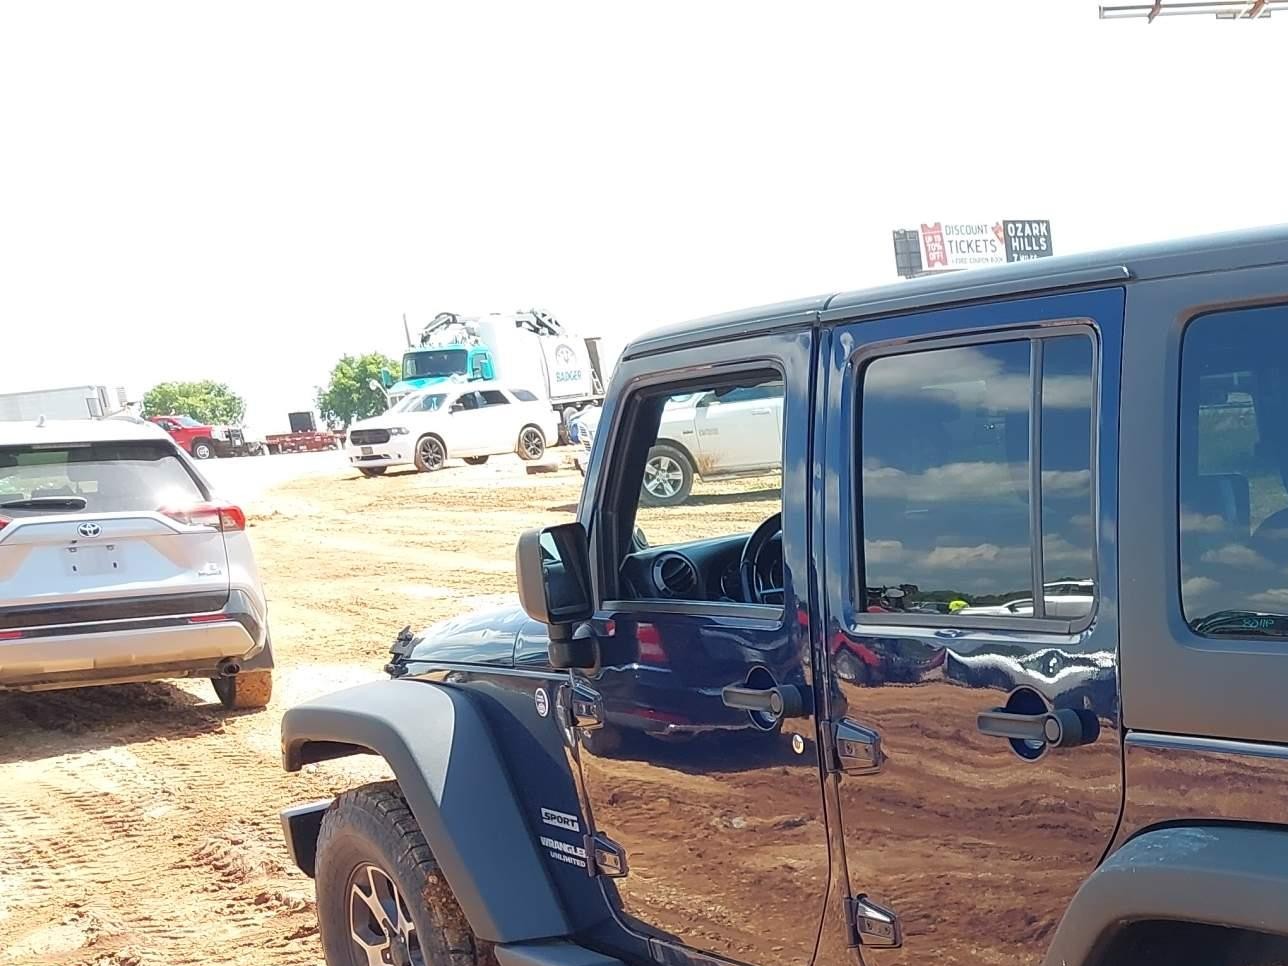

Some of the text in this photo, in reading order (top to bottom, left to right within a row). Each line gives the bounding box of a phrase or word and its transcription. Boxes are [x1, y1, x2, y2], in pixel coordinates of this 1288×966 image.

[945, 224, 989, 236] DISCOUNT
[1007, 222, 1048, 237] OZARK
[948, 239, 996, 254] TICKETS
[1011, 237, 1047, 251] HILLS
[555, 370, 582, 383] BADGER
[543, 812, 578, 828] SPORT
[550, 850, 586, 868] UNLIMITED
